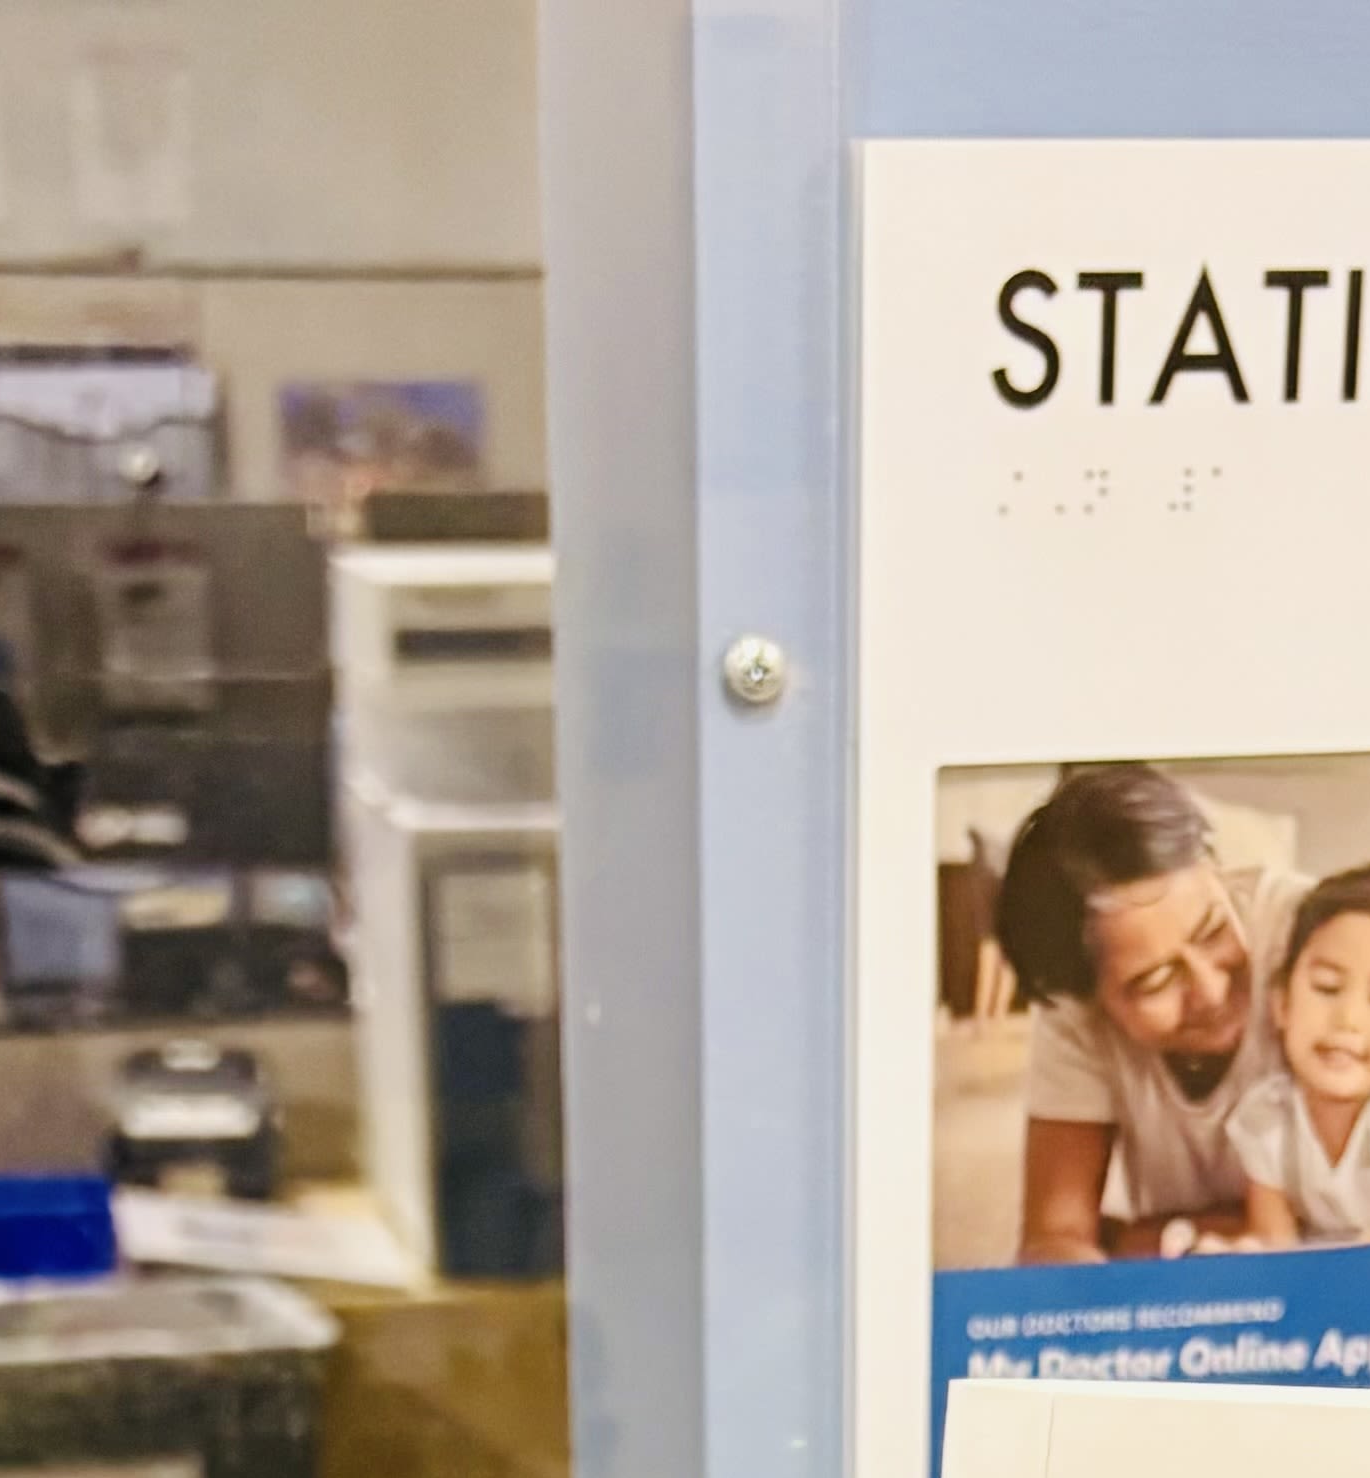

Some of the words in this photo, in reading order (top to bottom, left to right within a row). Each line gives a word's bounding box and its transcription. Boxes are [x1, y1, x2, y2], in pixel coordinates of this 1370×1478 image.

[966, 1315, 1018, 1341] OUR
[1134, 1299, 1285, 1330] RECOMMEND
[1038, 1346, 1173, 1380] Doctor
[1178, 1331, 1310, 1377] Online
